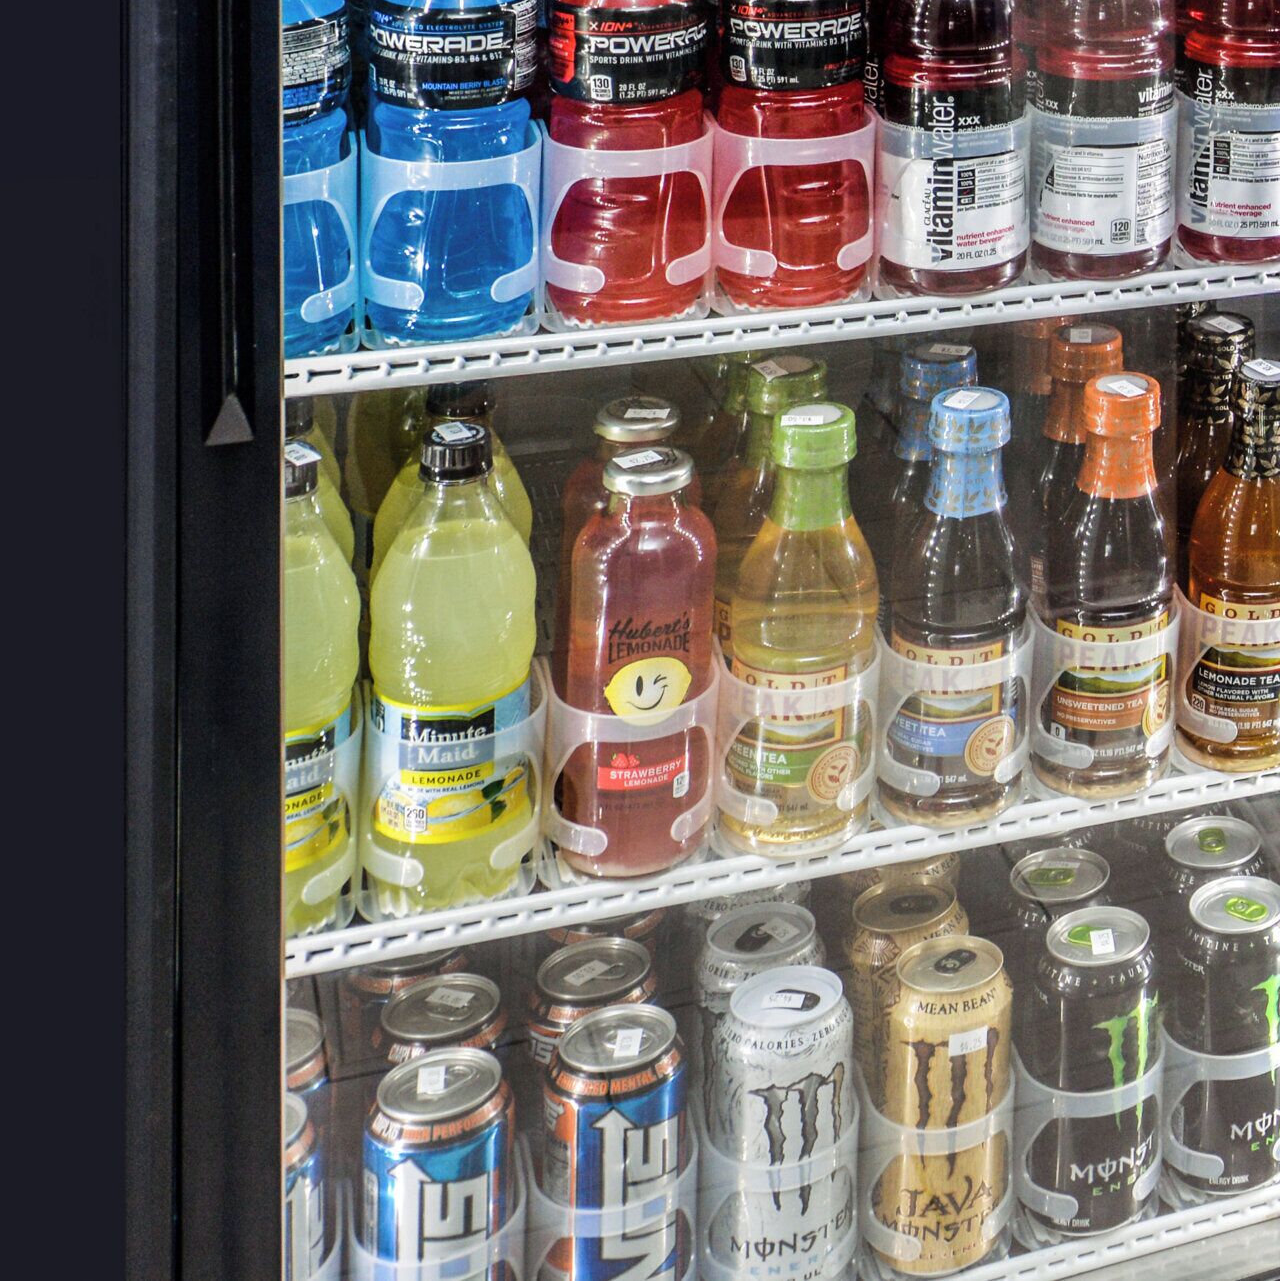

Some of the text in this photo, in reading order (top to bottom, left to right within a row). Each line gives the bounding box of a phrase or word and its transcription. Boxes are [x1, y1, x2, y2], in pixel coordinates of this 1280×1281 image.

[729, 12, 863, 41] POWERADE
[774, 38, 828, 49] WITH VITAMINS
[589, 53, 664, 65] SPORTS DRINK WITH
[421, 81, 482, 91] MOUNTAIN BERRY
[592, 77, 610, 89] 130
[923, 188, 932, 226] GLACÉAU
[1236, 203, 1272, 211] enhanced
[956, 225, 1015, 241] nutrient enhanced
[1112, 220, 1129, 233] 120
[956, 237, 978, 248] water
[956, 250, 973, 260] 20 FL
[608, 611, 691, 642] Hubert's
[1201, 618, 1280, 645] PEAK
[608, 631, 691, 665] LEMONADE
[1060, 645, 1139, 671] PEAK
[1198, 667, 1257, 686] LEMONADE
[1057, 696, 1144, 712] UNSWEETENED TEA
[1215, 692, 1275, 702] NATURAL FLAVORS
[417, 746, 479, 765] Maid
[762, 751, 788, 765] TEA
[412, 769, 482, 785] LEMONADE
[609, 759, 683, 781] STRAWBERRY
[442, 780, 486, 793] REAL LEMONS
[623, 774, 669, 788] LEMONADE
[917, 992, 995, 1015] MEAN BEAN
[812, 1022, 836, 1043] ZERO
[609, 1073, 656, 1093] MENTAL
[895, 1175, 993, 1218] JAVA
